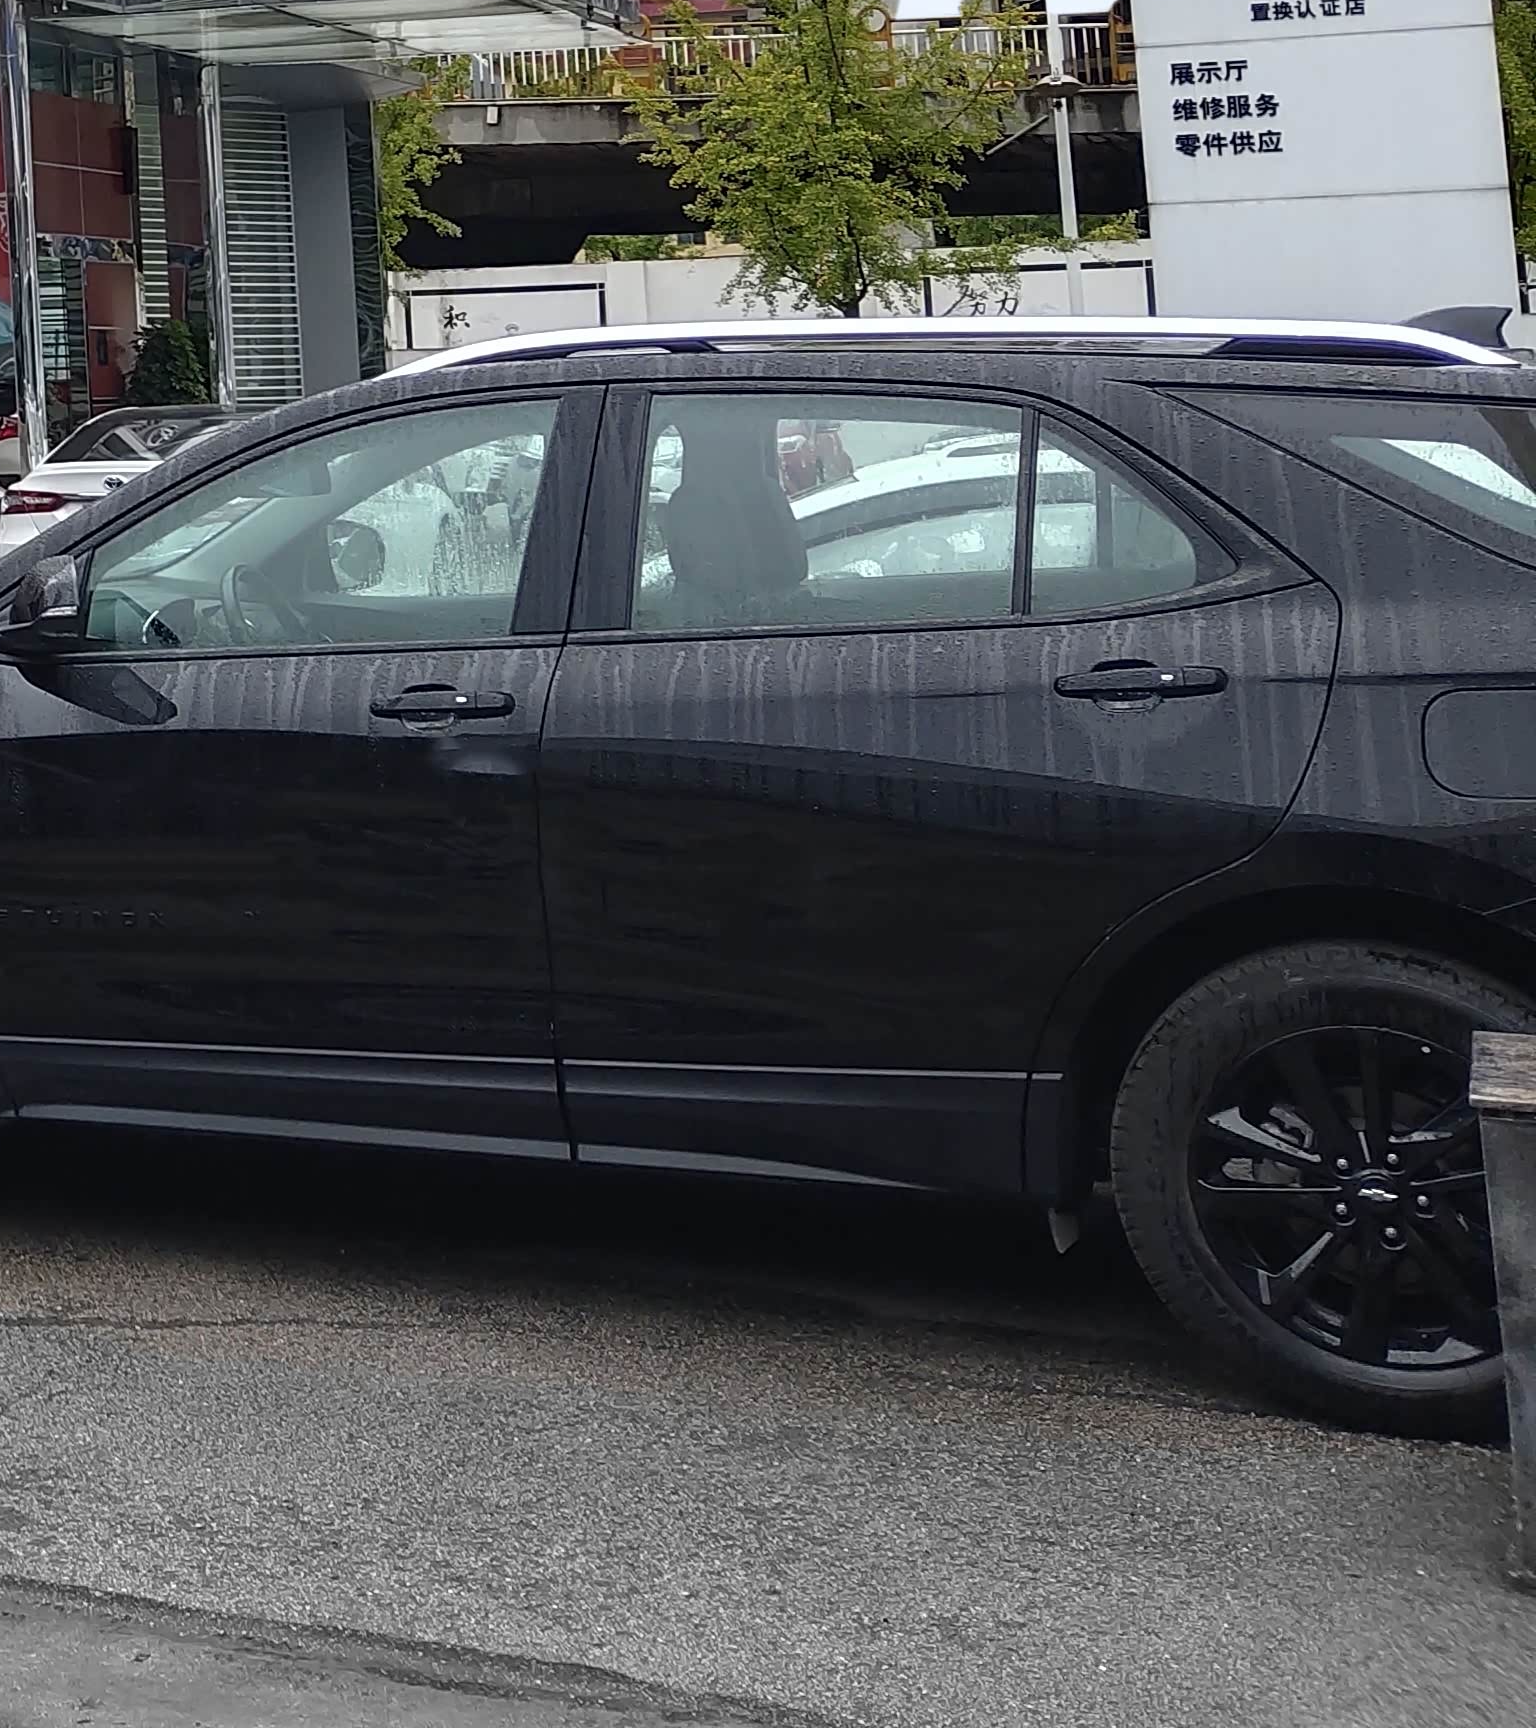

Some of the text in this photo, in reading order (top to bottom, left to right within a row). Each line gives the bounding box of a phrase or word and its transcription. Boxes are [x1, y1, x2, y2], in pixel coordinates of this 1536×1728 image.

[1169, 59, 1248, 87] 展示厅
[1172, 93, 1280, 122] 维修服务
[1175, 130, 1283, 159] 零件供应
